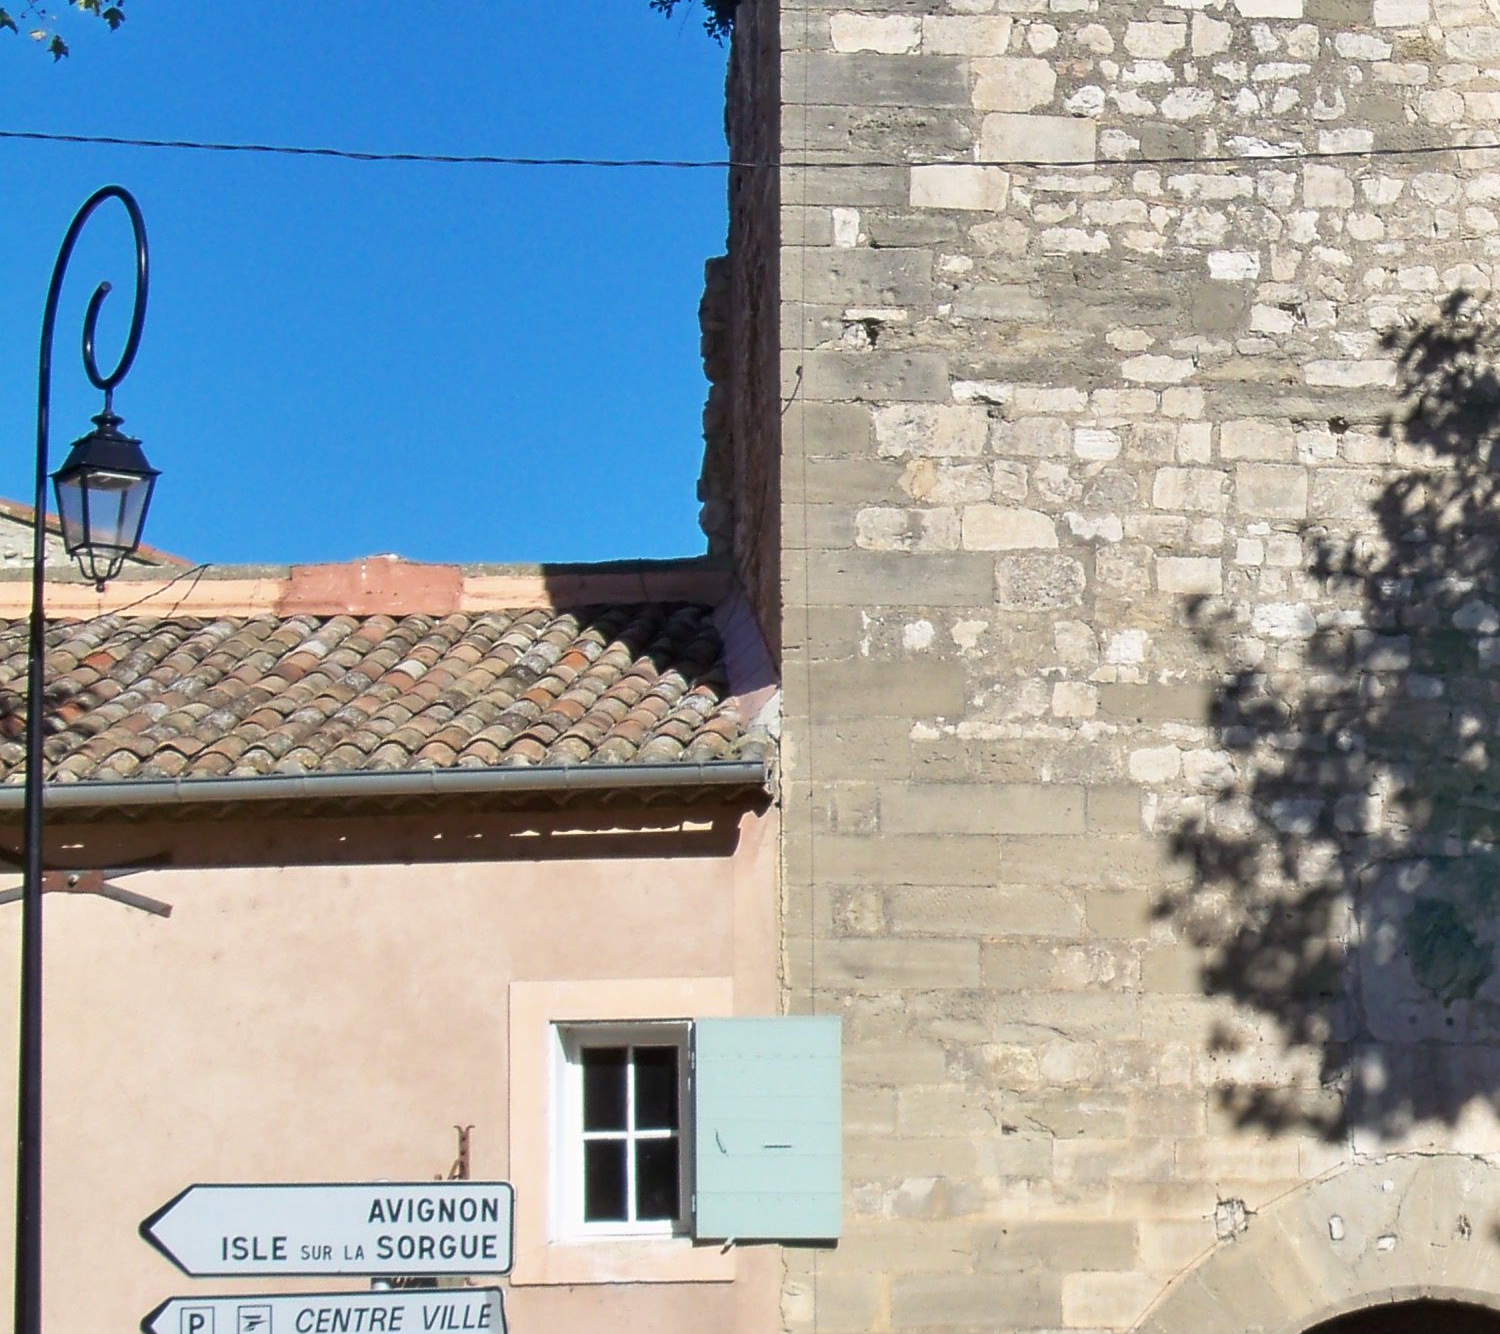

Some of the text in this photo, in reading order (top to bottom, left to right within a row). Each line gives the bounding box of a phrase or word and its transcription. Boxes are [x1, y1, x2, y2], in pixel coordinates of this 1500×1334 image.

[368, 1198, 499, 1223] AVIGNON
[221, 1235, 498, 1261] ISLE SUR LA SORGUE
[295, 1303, 492, 1333] CENTRE VILLE
